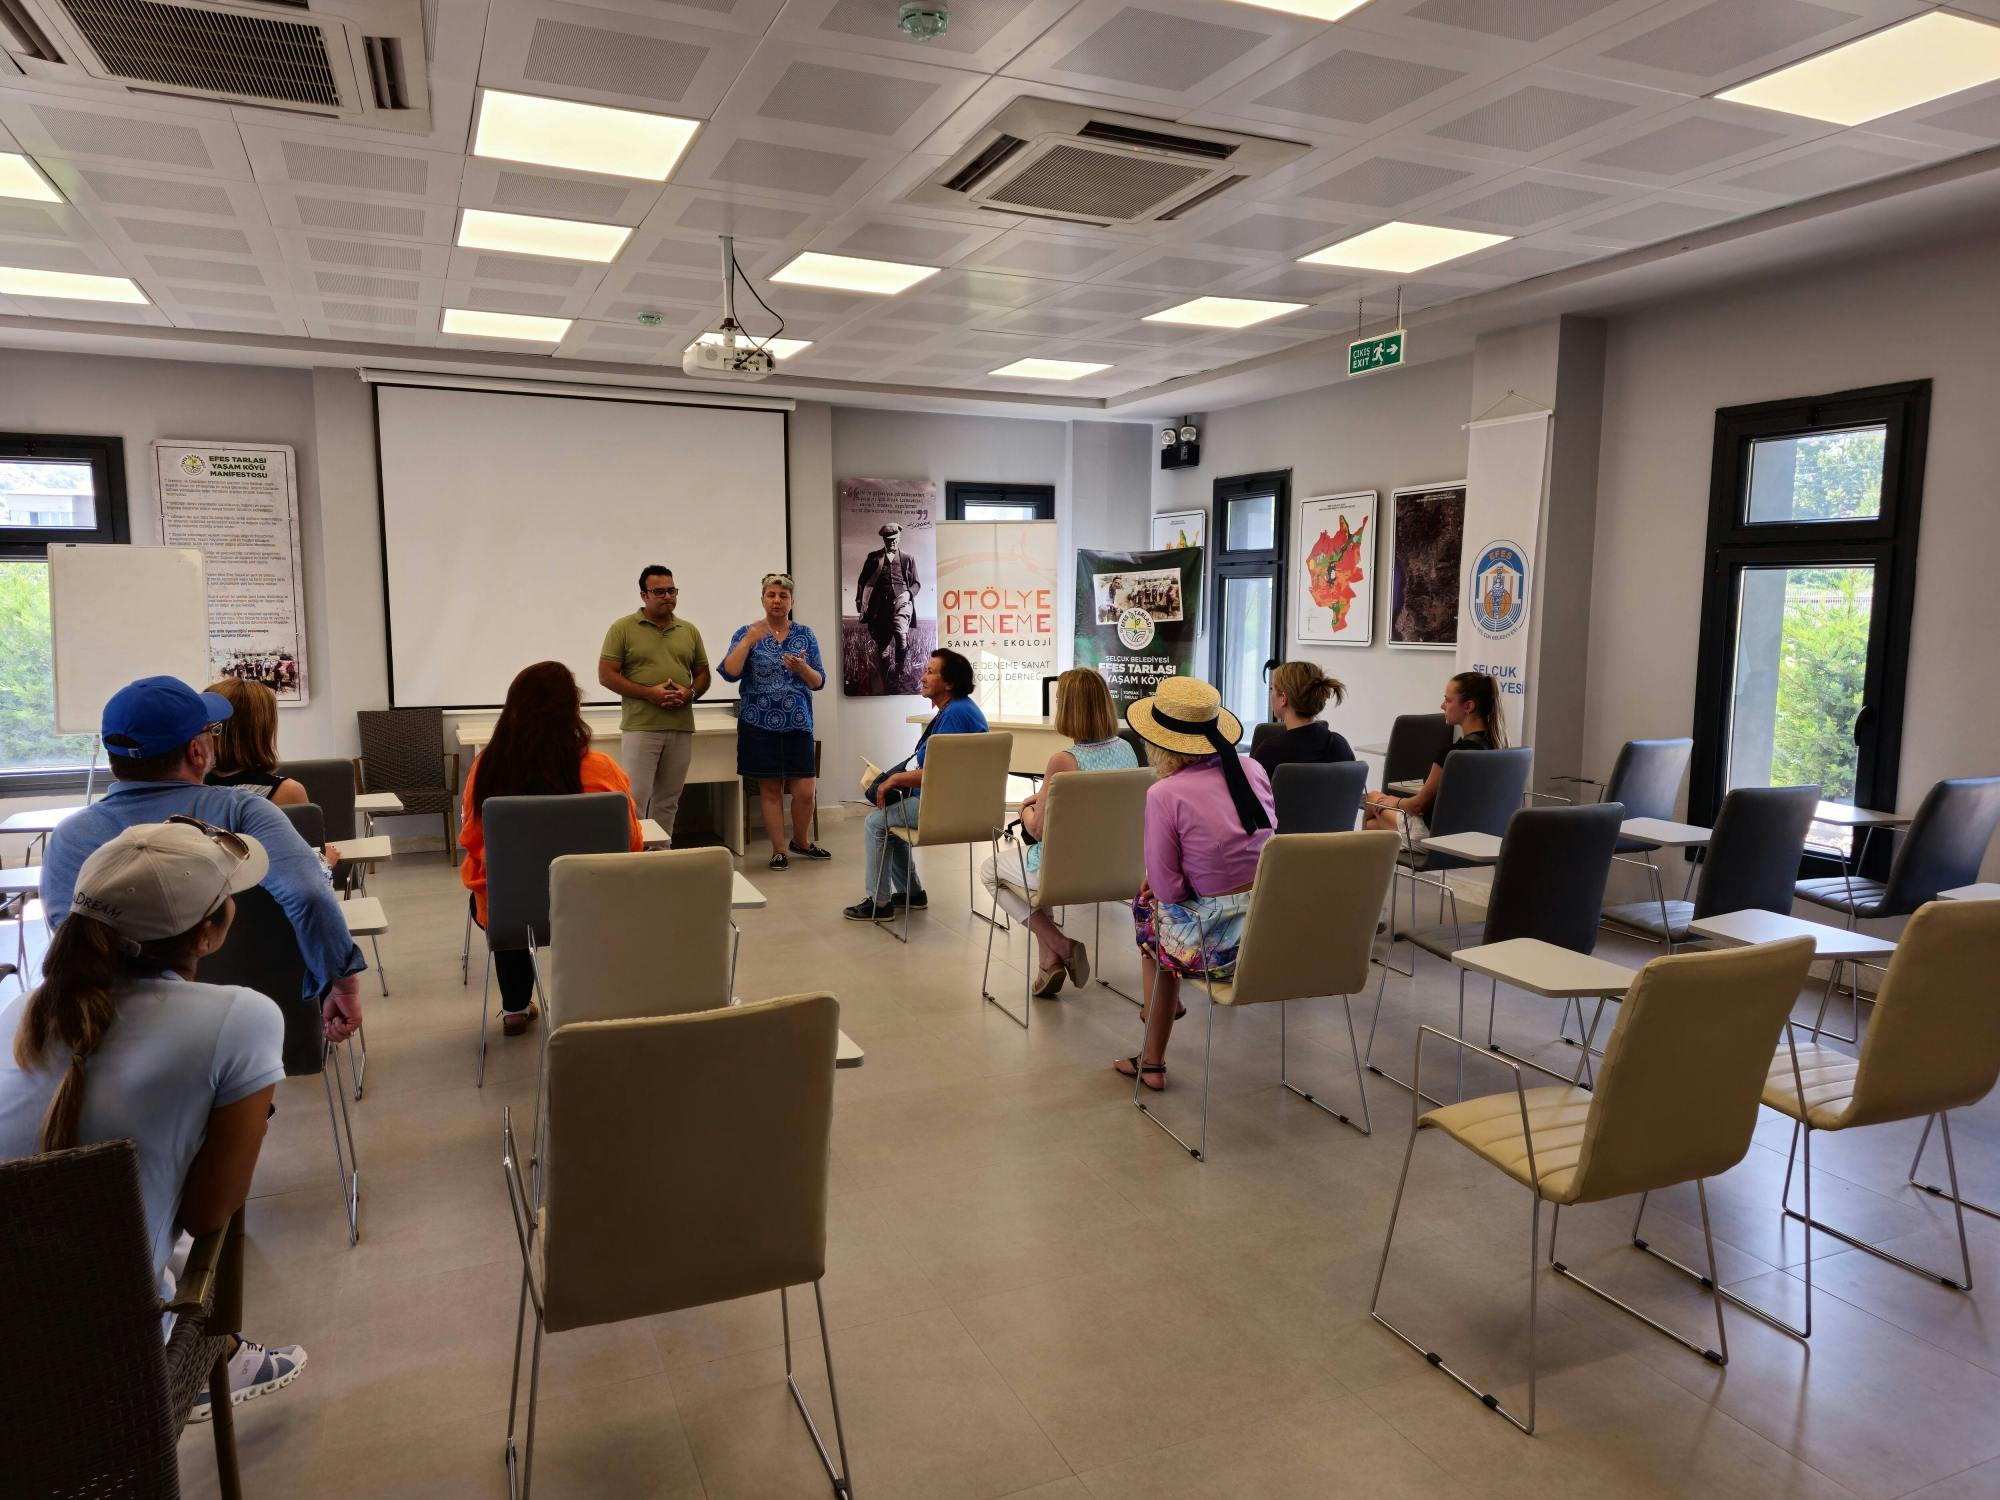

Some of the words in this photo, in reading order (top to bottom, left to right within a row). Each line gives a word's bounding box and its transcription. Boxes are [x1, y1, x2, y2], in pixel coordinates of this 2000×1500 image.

[1352, 357, 1370, 369] EXIT
[231, 456, 267, 464] TARLASI
[210, 470, 268, 479] MANİFESTOSU
[1489, 550, 1513, 561] EFES
[946, 613, 1051, 635] DENEME
[1134, 610, 1152, 628] TARLASI
[947, 640, 985, 648] SANAT
[1003, 638, 1051, 647] EKOLOJİ
[1105, 655, 1130, 663] SELÇUK
[1130, 656, 1170, 664] BELEDİYESİ
[981, 661, 1019, 670] DENEME
[1021, 660, 1051, 669] SANAT
[1098, 662, 1126, 673] EFES
[1128, 663, 1177, 675] TARLASI
[1107, 675, 1139, 685] YAŞAM
